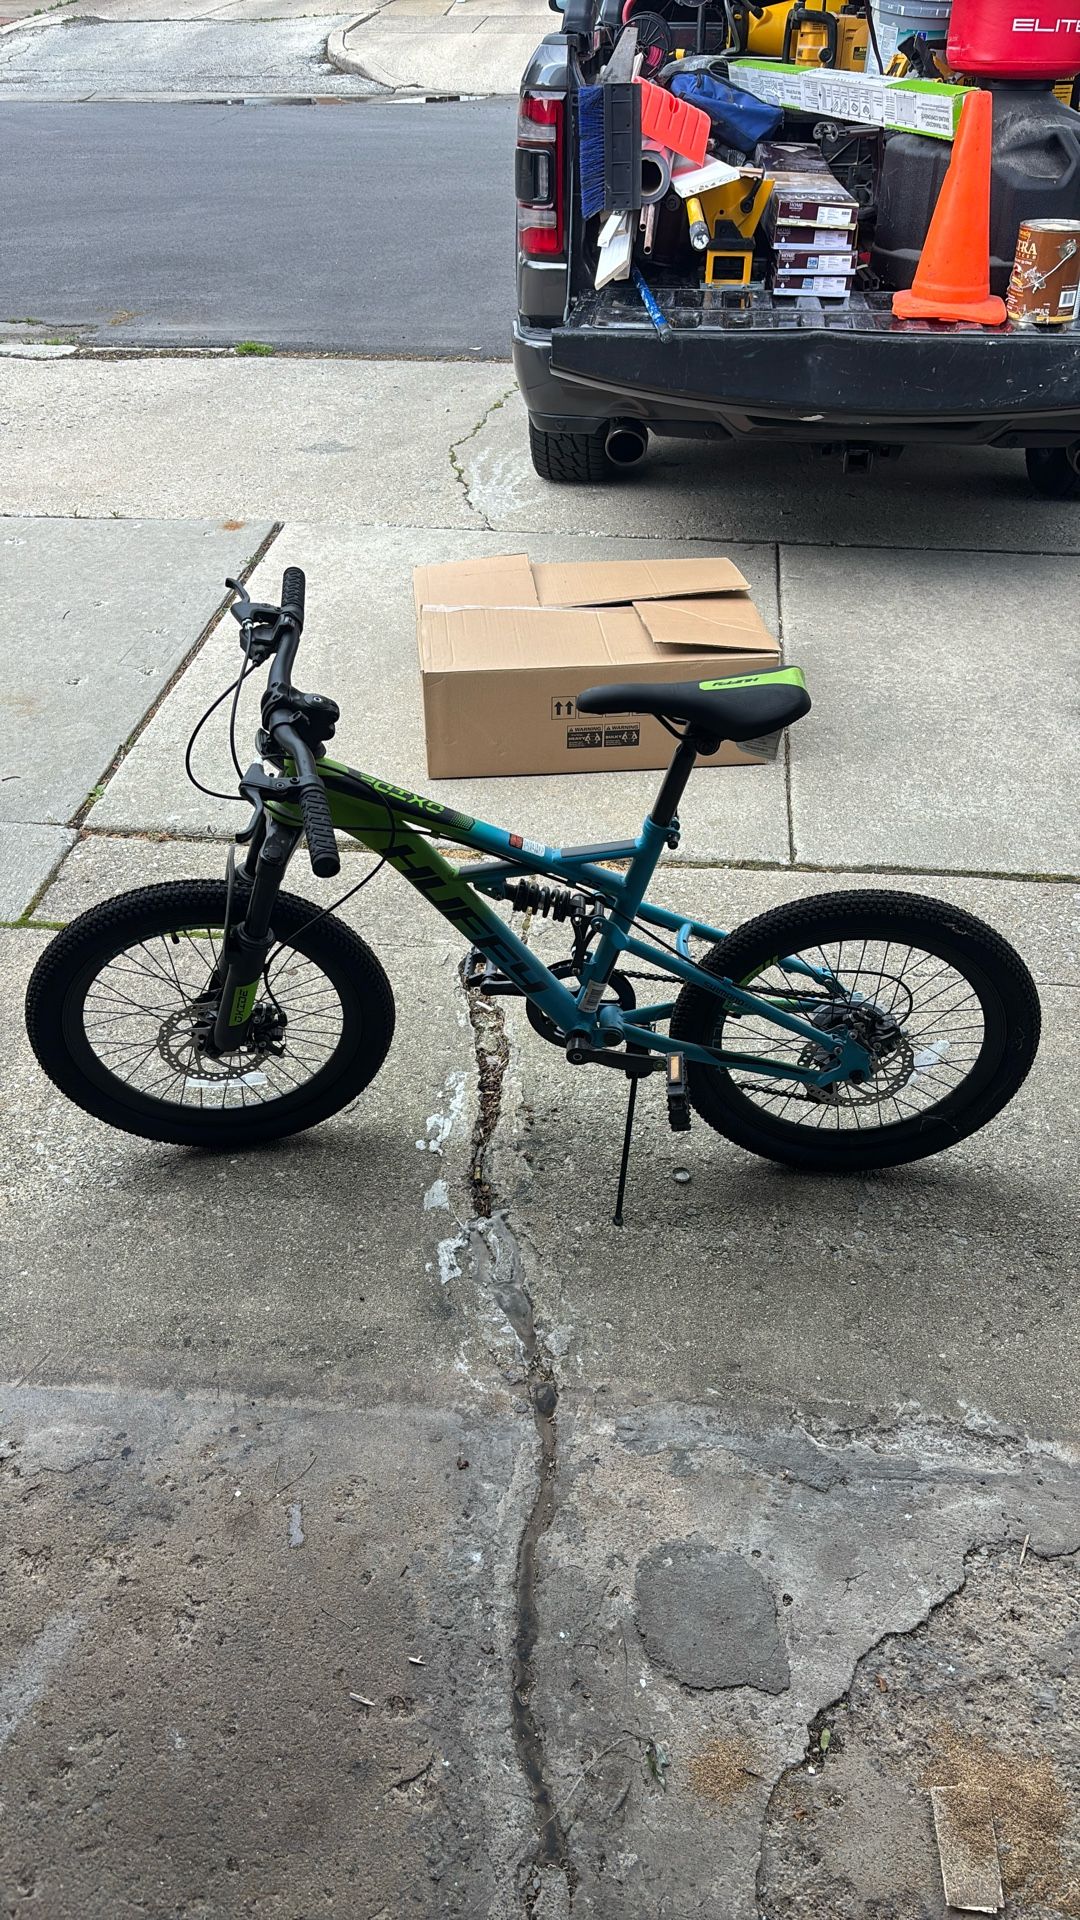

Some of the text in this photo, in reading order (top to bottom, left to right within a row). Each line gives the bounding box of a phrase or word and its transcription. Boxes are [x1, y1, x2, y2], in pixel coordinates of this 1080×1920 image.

[1012, 18, 1080, 33] ELIT
[359, 773, 446, 815] OXIDE
[378, 844, 550, 994] HUFFY
